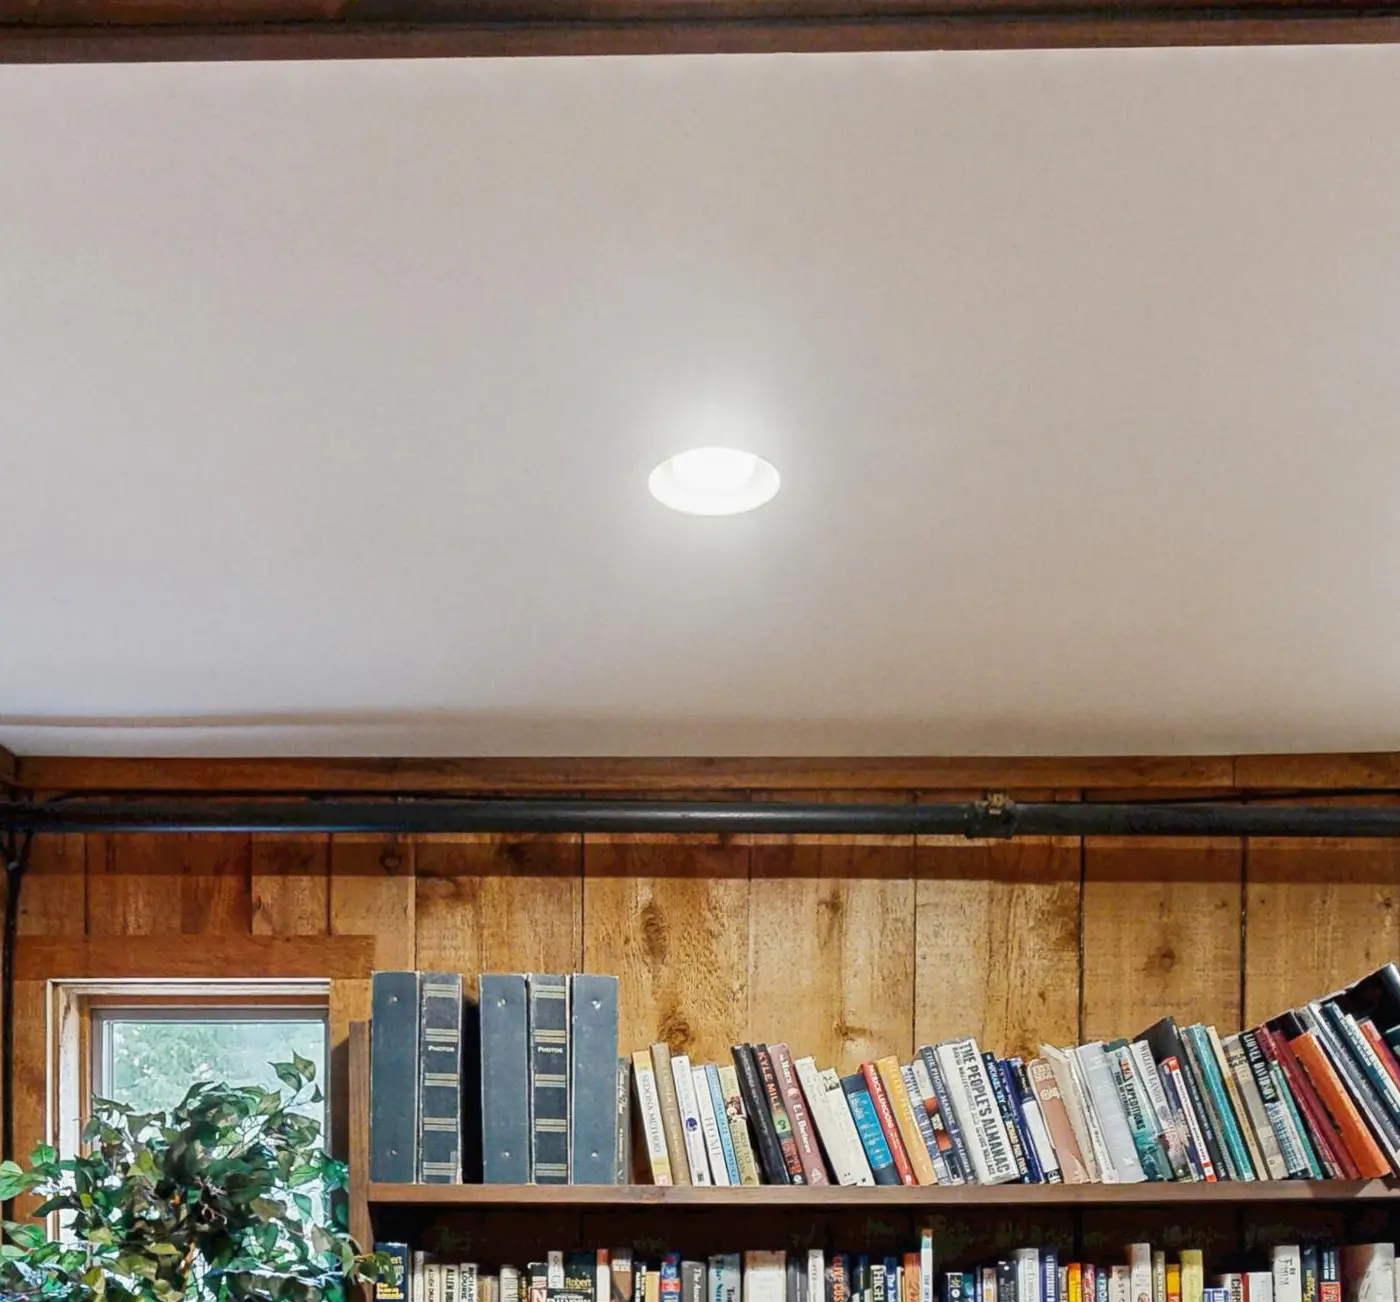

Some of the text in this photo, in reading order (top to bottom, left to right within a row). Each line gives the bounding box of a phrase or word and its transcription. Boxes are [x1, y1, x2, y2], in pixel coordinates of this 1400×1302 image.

[756, 1050, 773, 1082] KYLE
[958, 1041, 1010, 1174] THE PEOPLE'S ALMANAC
[1122, 1082, 1146, 1131] EXPEDITIONS
[646, 1112, 661, 1152] METHOD
[445, 1268, 454, 1290] ALLEN
[693, 1267, 701, 1282] The
[873, 1270, 883, 1300] HIGH
